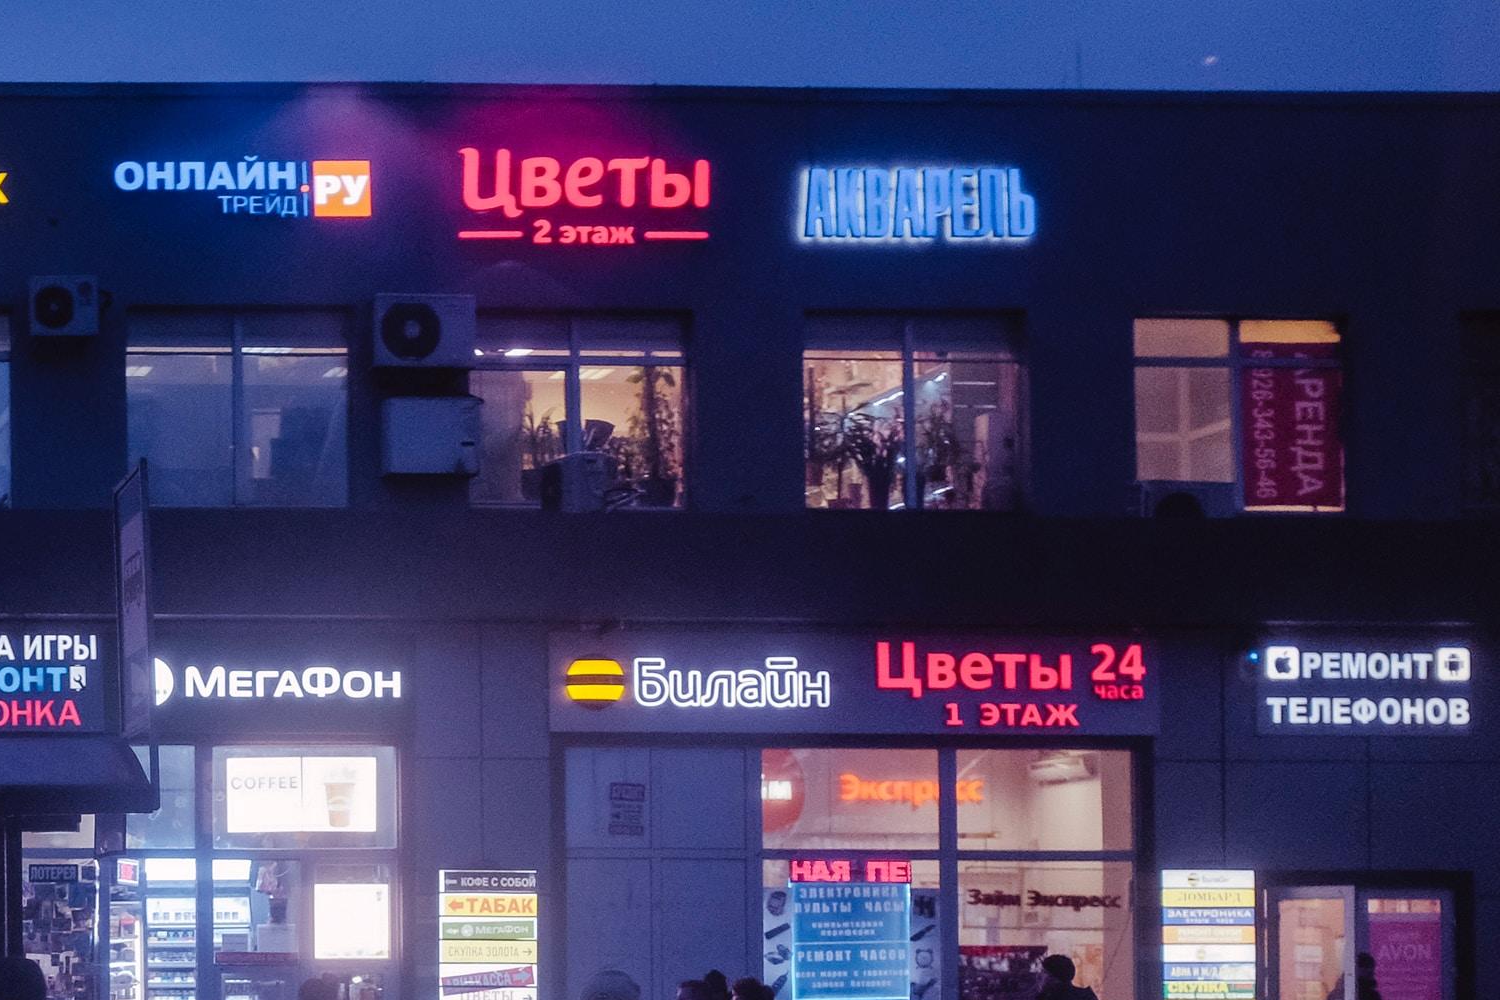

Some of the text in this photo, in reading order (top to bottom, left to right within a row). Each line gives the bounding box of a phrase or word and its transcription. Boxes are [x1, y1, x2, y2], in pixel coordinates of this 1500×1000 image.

[113, 155, 297, 192] ОНЛАЙН
[218, 193, 299, 218] ТРЕЙД
[802, 167, 1037, 238] АКВАРЕЛЬ
[532, 219, 635, 245] 2 этаж
[22, 634, 98, 662] ИГРЫ
[875, 641, 1148, 699] Цветы 24
[1302, 652, 1434, 680] РЕМОНТ
[1093, 684, 1146, 700] часа
[945, 703, 1080, 727] 1 ЭТАЖ
[1265, 696, 1472, 725] ТЕЛЕФОНОВ
[230, 776, 299, 791] COFFEE
[839, 773, 984, 811] Экспрсс
[30, 864, 77, 881] ЛОТЕРЕЯ
[460, 874, 537, 888] КОФЕ С СОБОЙ
[791, 860, 912, 883] НАЯ ПЕ
[799, 886, 899, 899] ЭЛЕКТРОНИКА
[1026, 889, 1122, 912] Экспресс
[466, 898, 534, 914] ТАБАК
[864, 900, 905, 913] ЧАСЫ
[1167, 909, 1252, 919] ЭЛЕКТРОНИКА
[448, 944, 520, 958] СКУПКА ЗОЛОТА
[797, 948, 906, 962] РЕМОНТ ЧАСОВ
[1168, 982, 1229, 993] СКУПКА
